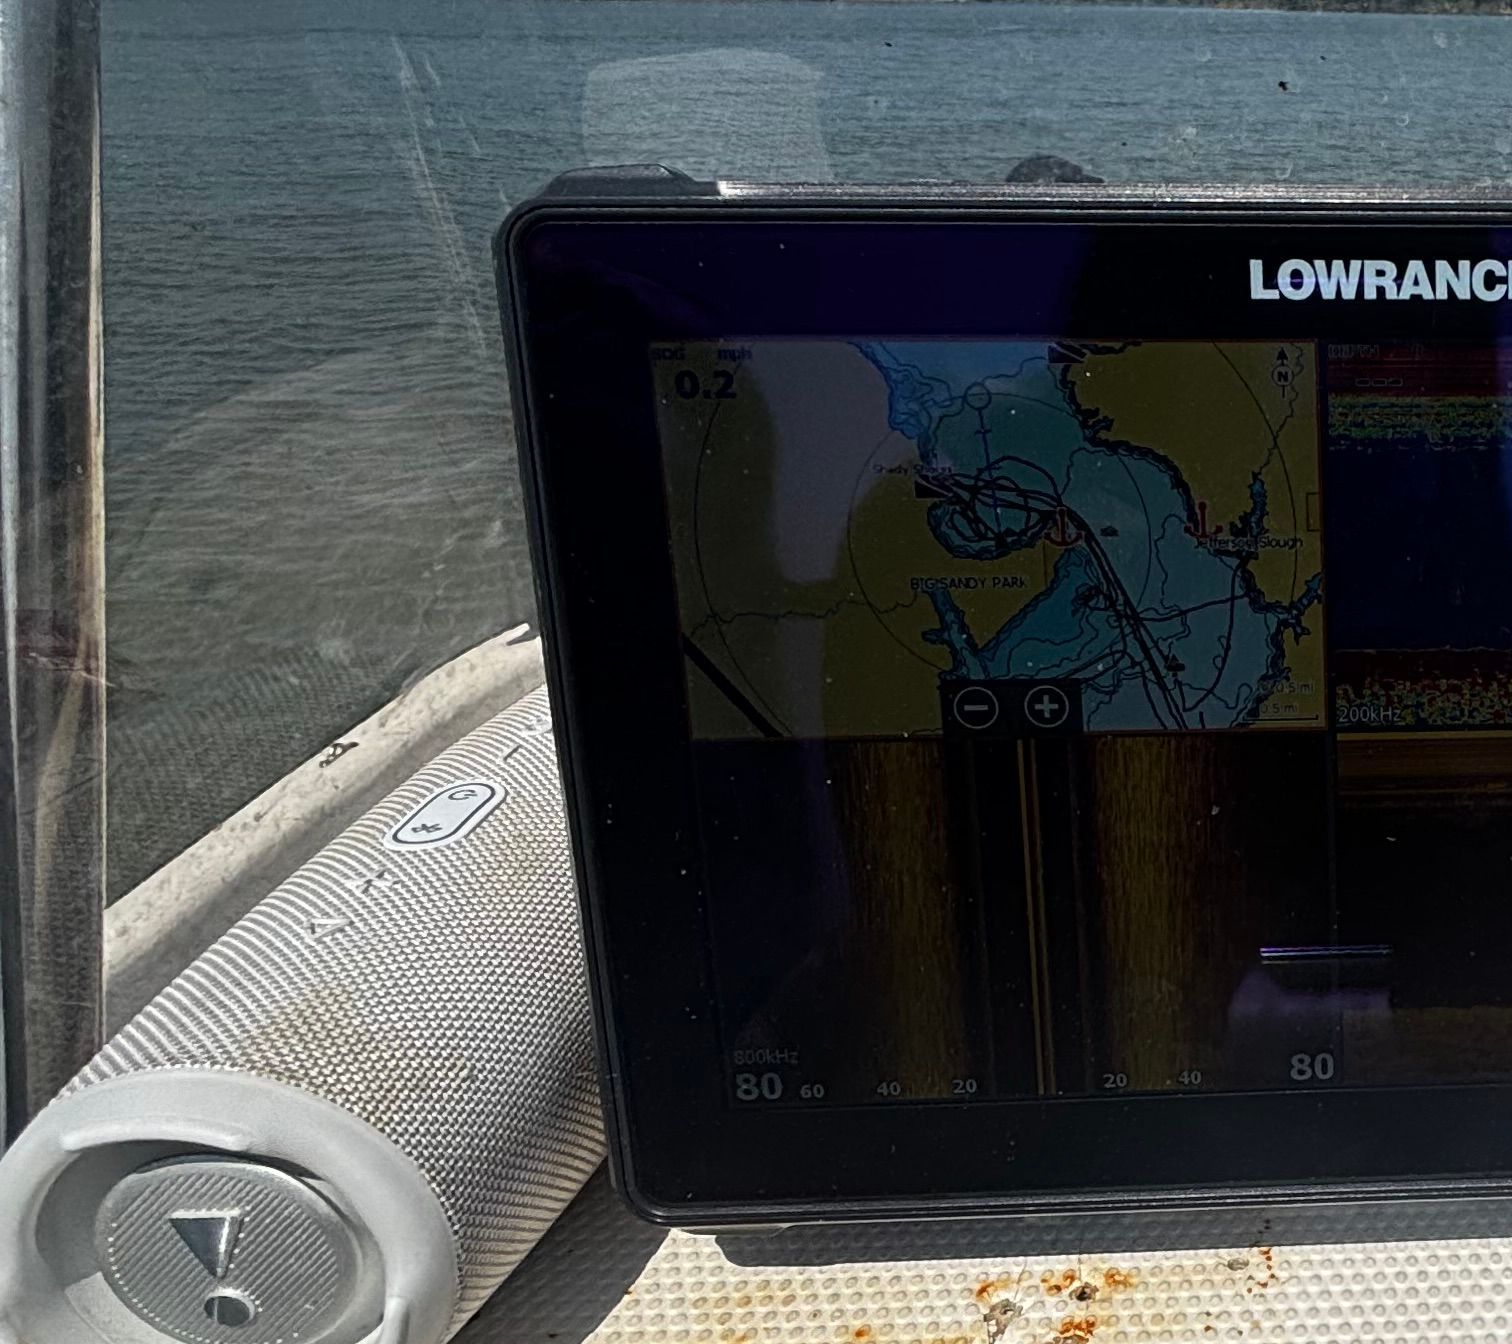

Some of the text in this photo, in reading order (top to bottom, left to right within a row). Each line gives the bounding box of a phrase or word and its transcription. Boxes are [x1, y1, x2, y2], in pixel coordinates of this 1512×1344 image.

[675, 370, 737, 399] 0.2
[1260, 536, 1304, 551] Slough
[911, 576, 1026, 590] BIG SANDY PARK
[1337, 707, 1401, 723] 200kHz
[1102, 1053, 1336, 1089] 20 40 80
[736, 1072, 977, 1101] 80 60 40 20
